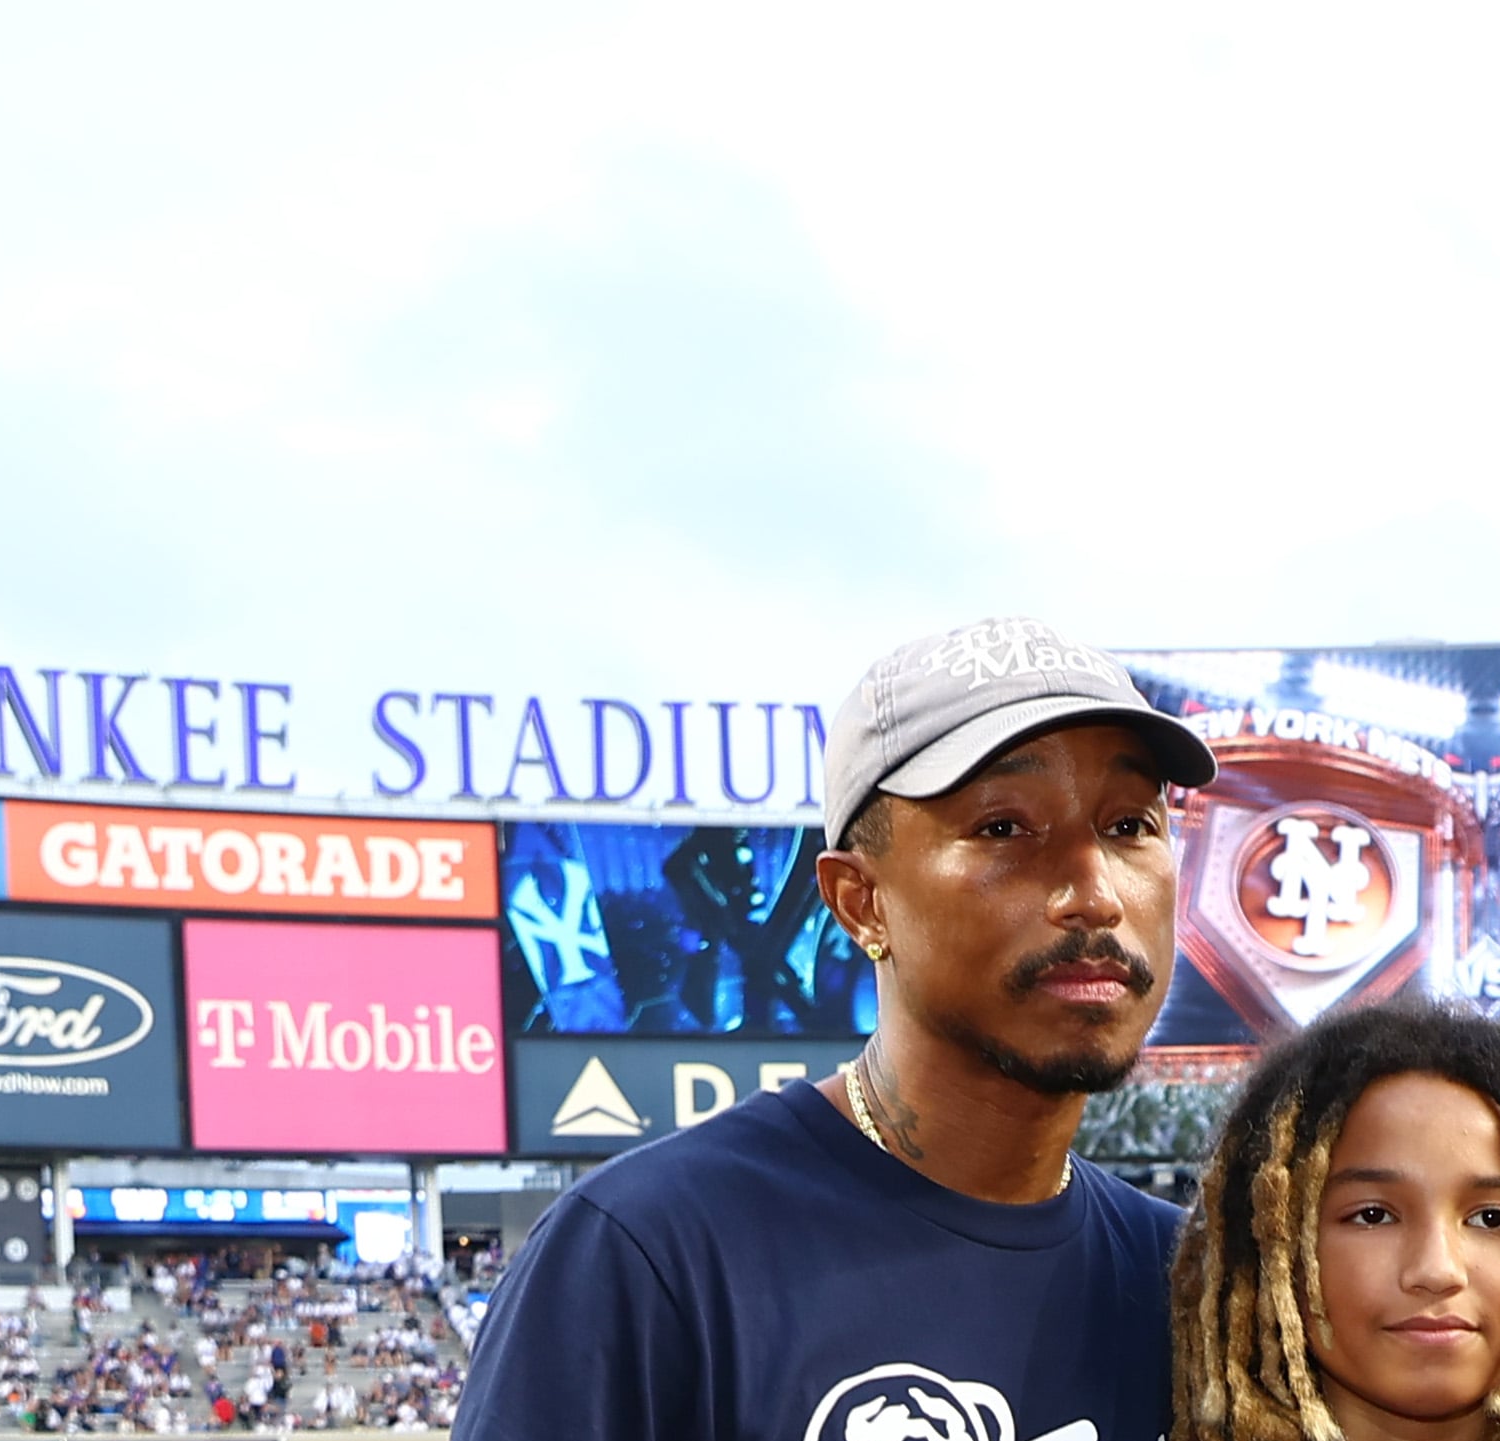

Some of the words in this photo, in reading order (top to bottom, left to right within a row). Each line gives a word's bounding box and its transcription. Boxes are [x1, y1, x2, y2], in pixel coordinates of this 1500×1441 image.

[371, 688, 826, 806] STADIU
[1248, 708, 1361, 750] YORK
[38, 818, 465, 900] GATORADE
[266, 1002, 496, 1074] Mobile
